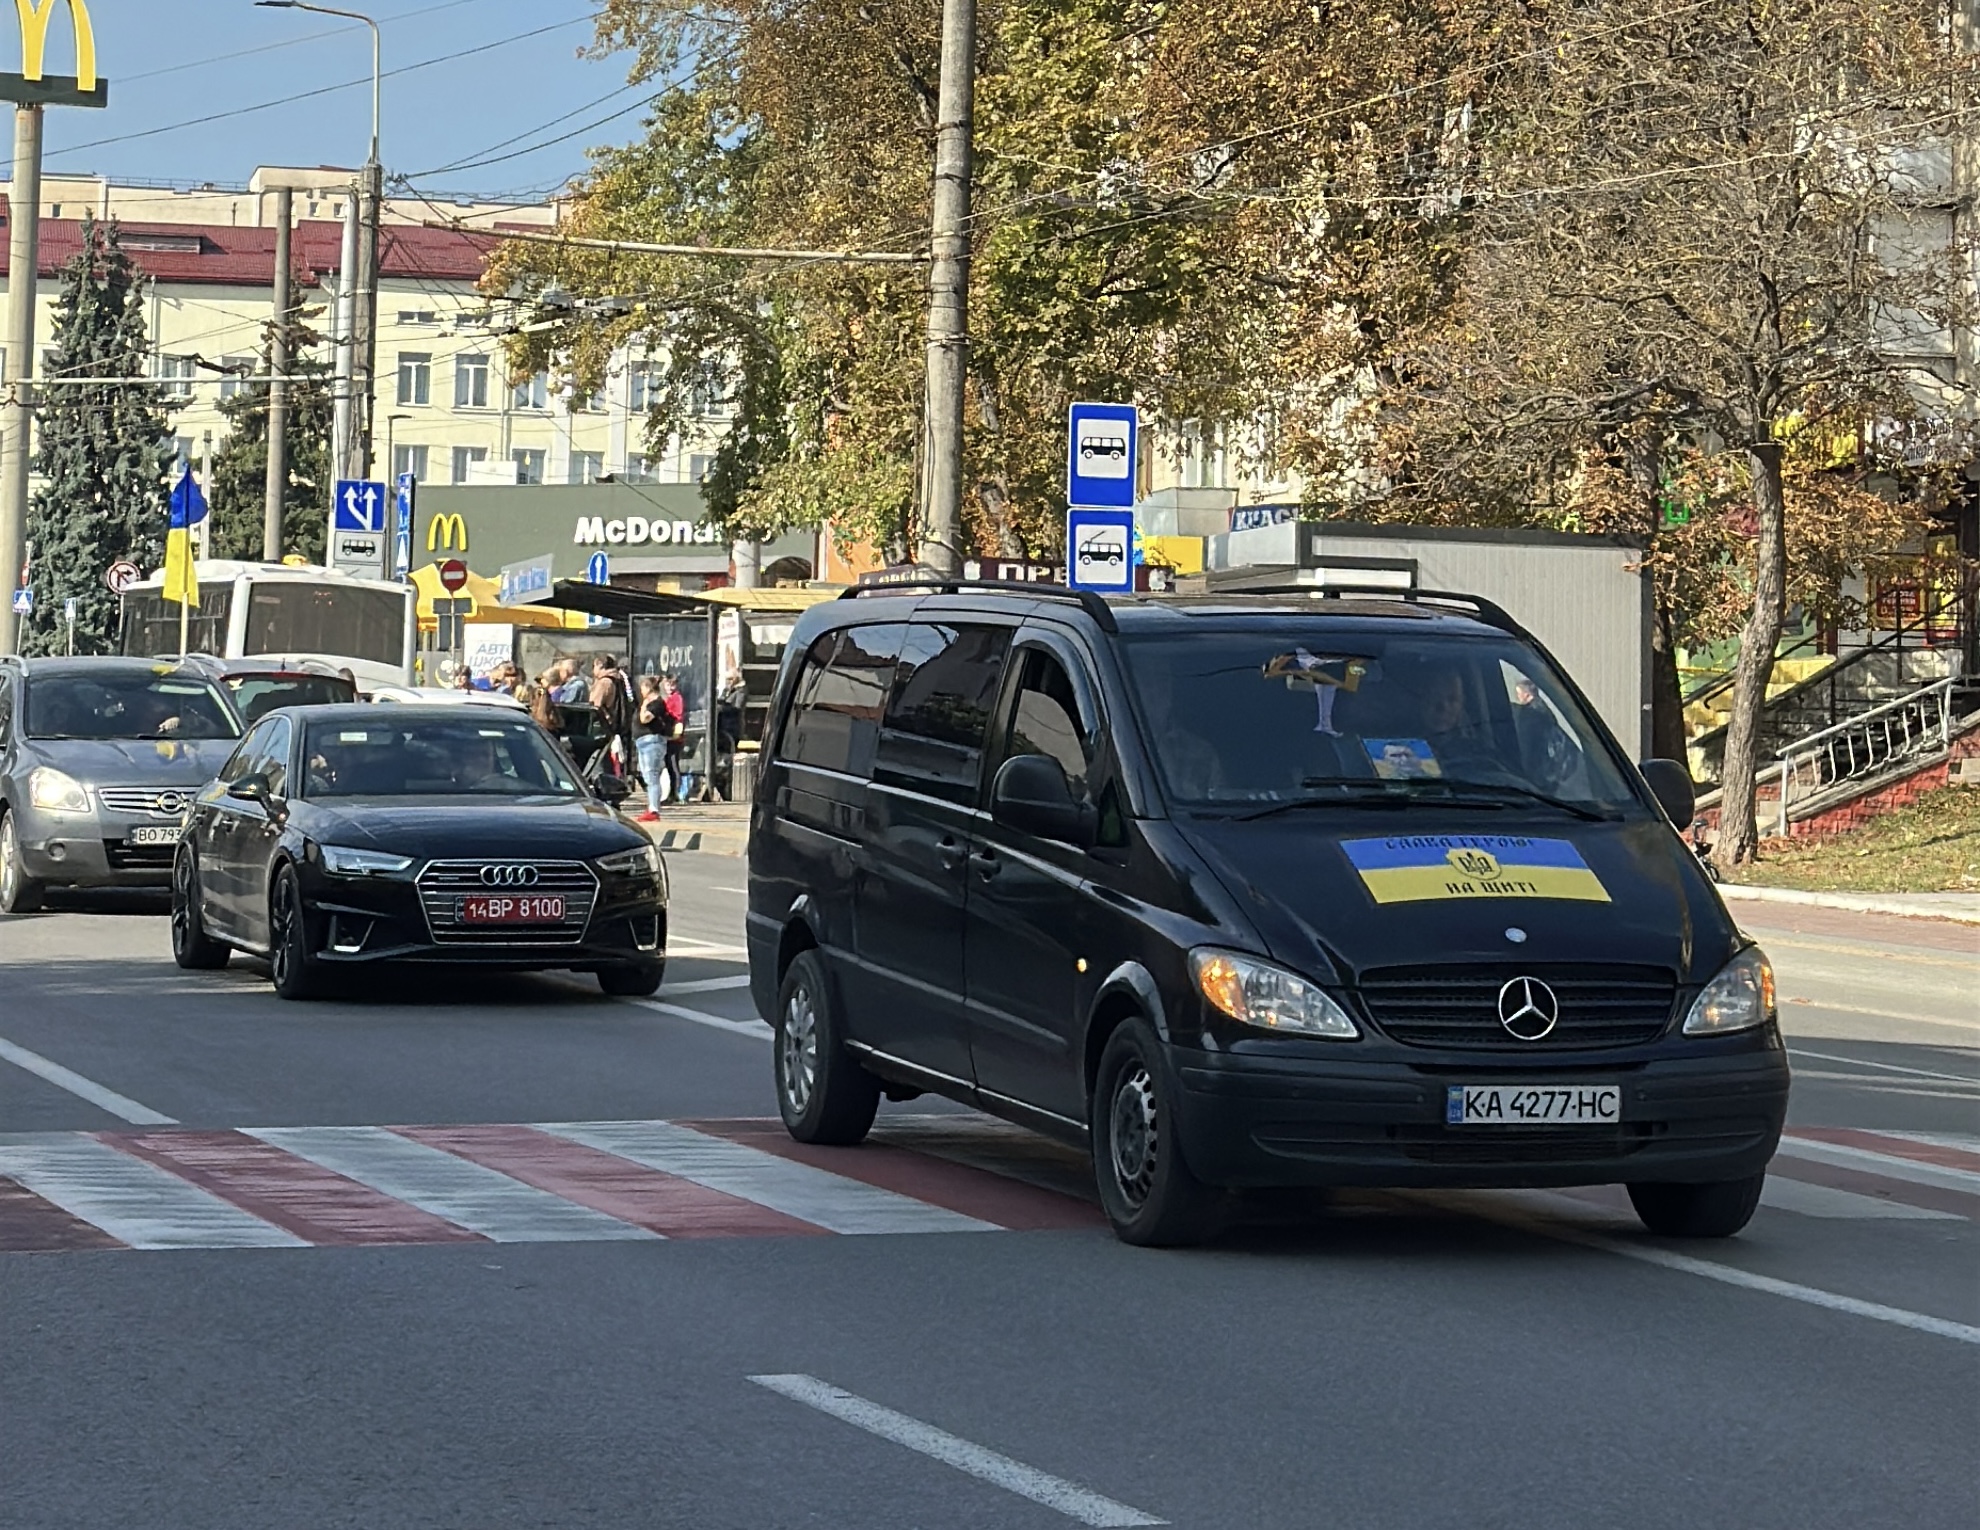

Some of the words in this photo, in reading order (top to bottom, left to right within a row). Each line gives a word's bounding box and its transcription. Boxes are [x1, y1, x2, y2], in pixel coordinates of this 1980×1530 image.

[574, 516, 772, 544] McDona
[469, 656, 512, 668] ШКО
[1445, 882, 1475, 894] НА
[519, 899, 562, 917] 8100
[1465, 1090, 1503, 1118] KA
[1510, 1091, 1572, 1118] 4277
